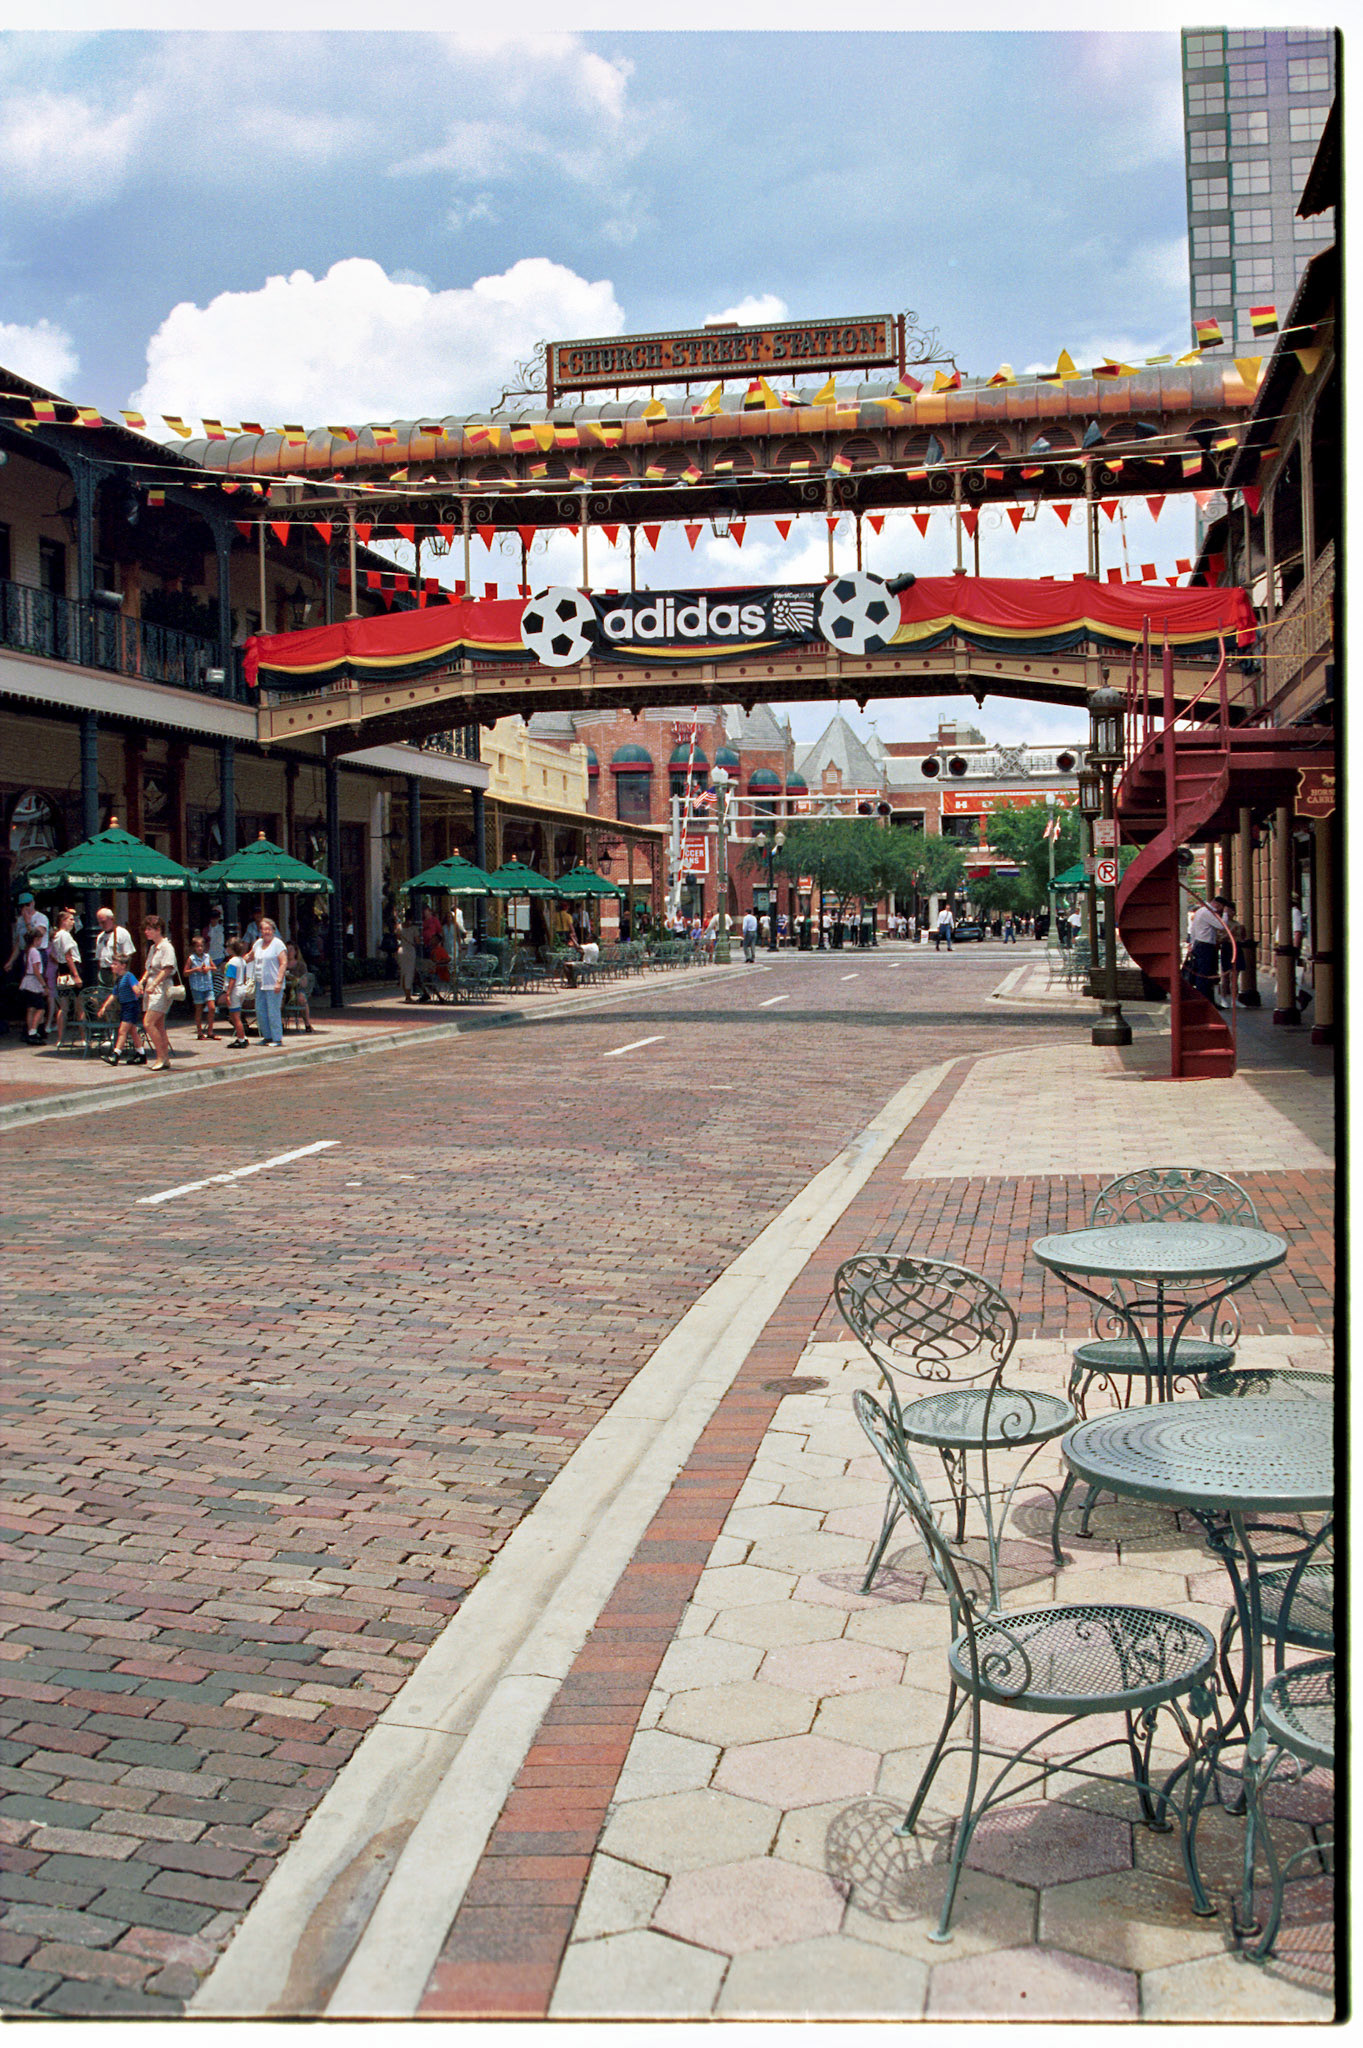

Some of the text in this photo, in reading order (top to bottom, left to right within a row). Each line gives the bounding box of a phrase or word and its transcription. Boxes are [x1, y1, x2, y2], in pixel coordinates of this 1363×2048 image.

[567, 326, 879, 376] CHURCH STREET STATION
[603, 596, 766, 639] adidas
